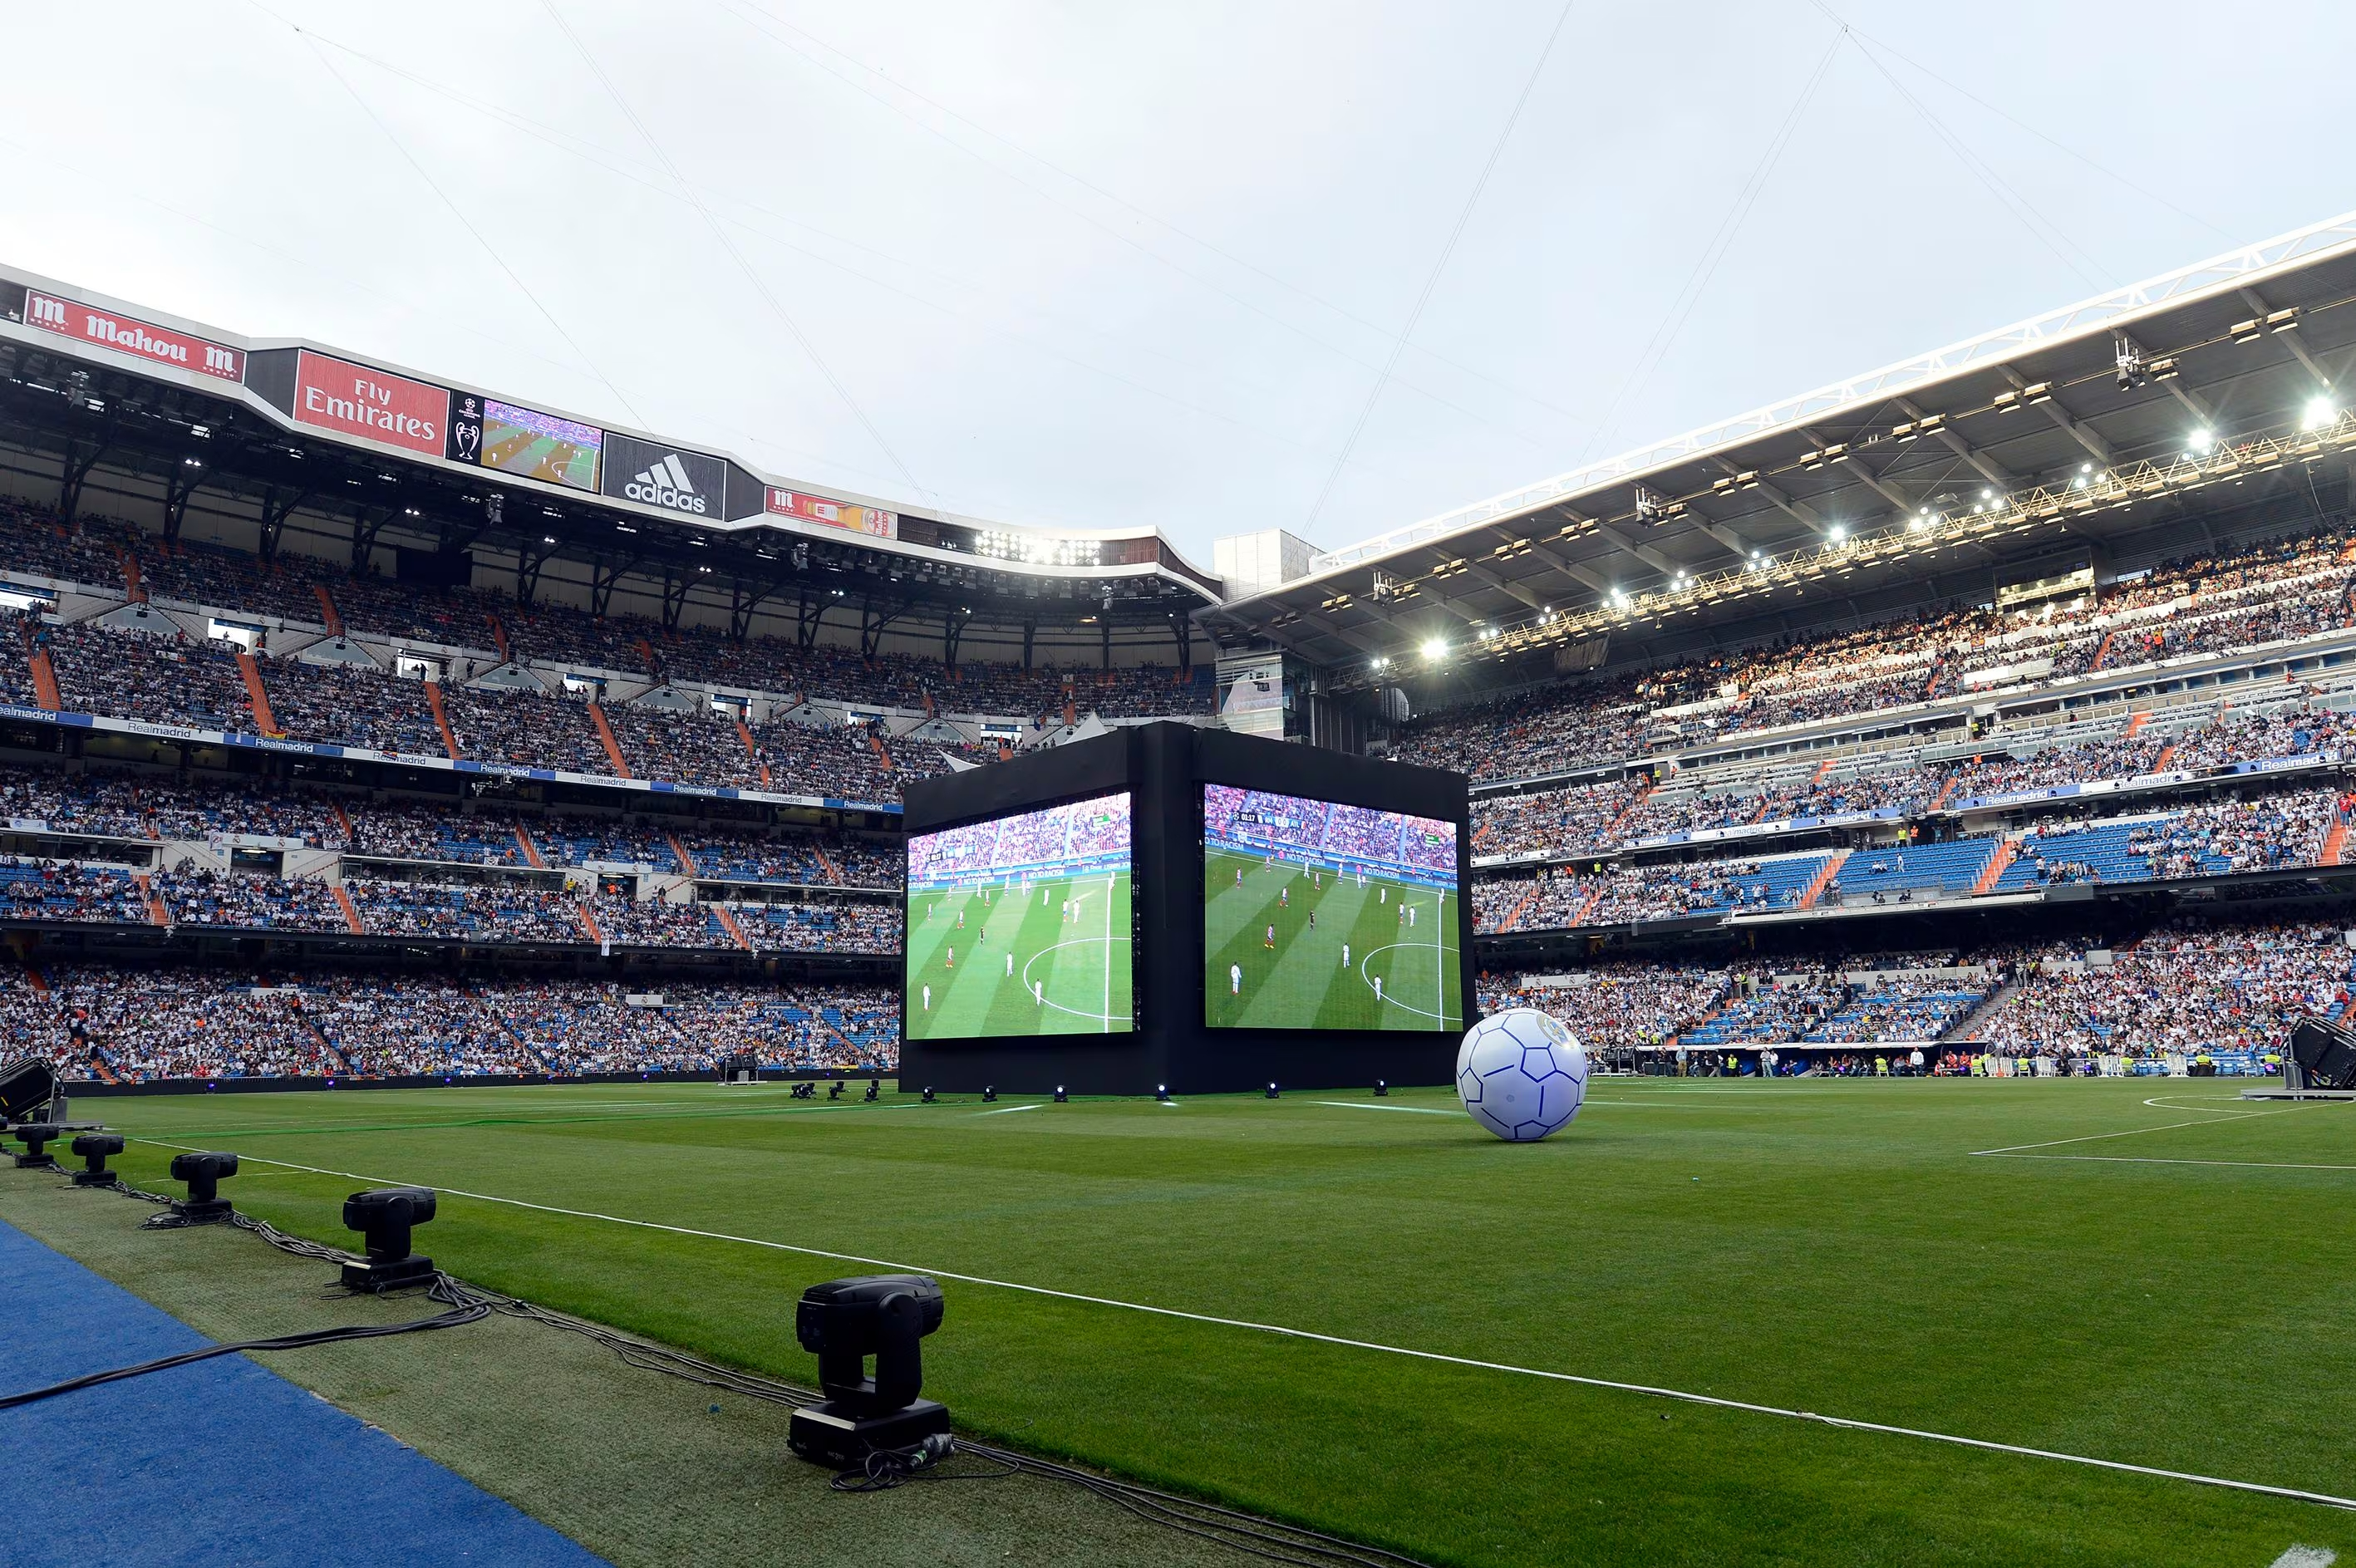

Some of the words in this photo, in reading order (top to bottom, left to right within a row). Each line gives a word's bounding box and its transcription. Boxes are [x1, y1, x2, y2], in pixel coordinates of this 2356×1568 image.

[86, 315, 188, 362] Mahou
[355, 378, 391, 406] Fly
[305, 386, 435, 440] Emirates
[624, 483, 706, 514] adidas
[0, 706, 57, 721] ealmadrid
[127, 722, 191, 738] Realmadrid
[255, 738, 314, 753] Realmadrid
[372, 752, 426, 765] Remadrid
[2261, 751, 2338, 771] Realmadid
[580, 775, 627, 786] Realmadrid
[673, 784, 717, 796] Realmadrid
[760, 793, 802, 804] Realmadrid
[1985, 789, 2048, 805] Realmadrid
[844, 800, 883, 811] Realmadrid
[1715, 825, 1764, 838] Ralmadrid
[1211, 838, 1220, 846] TO
[1221, 840, 1244, 851] RACISM
[1623, 836, 1669, 848] Relmadrid
[1286, 853, 1296, 862] NO
[1296, 854, 1304, 863] TO
[1364, 867, 1372, 875] NO
